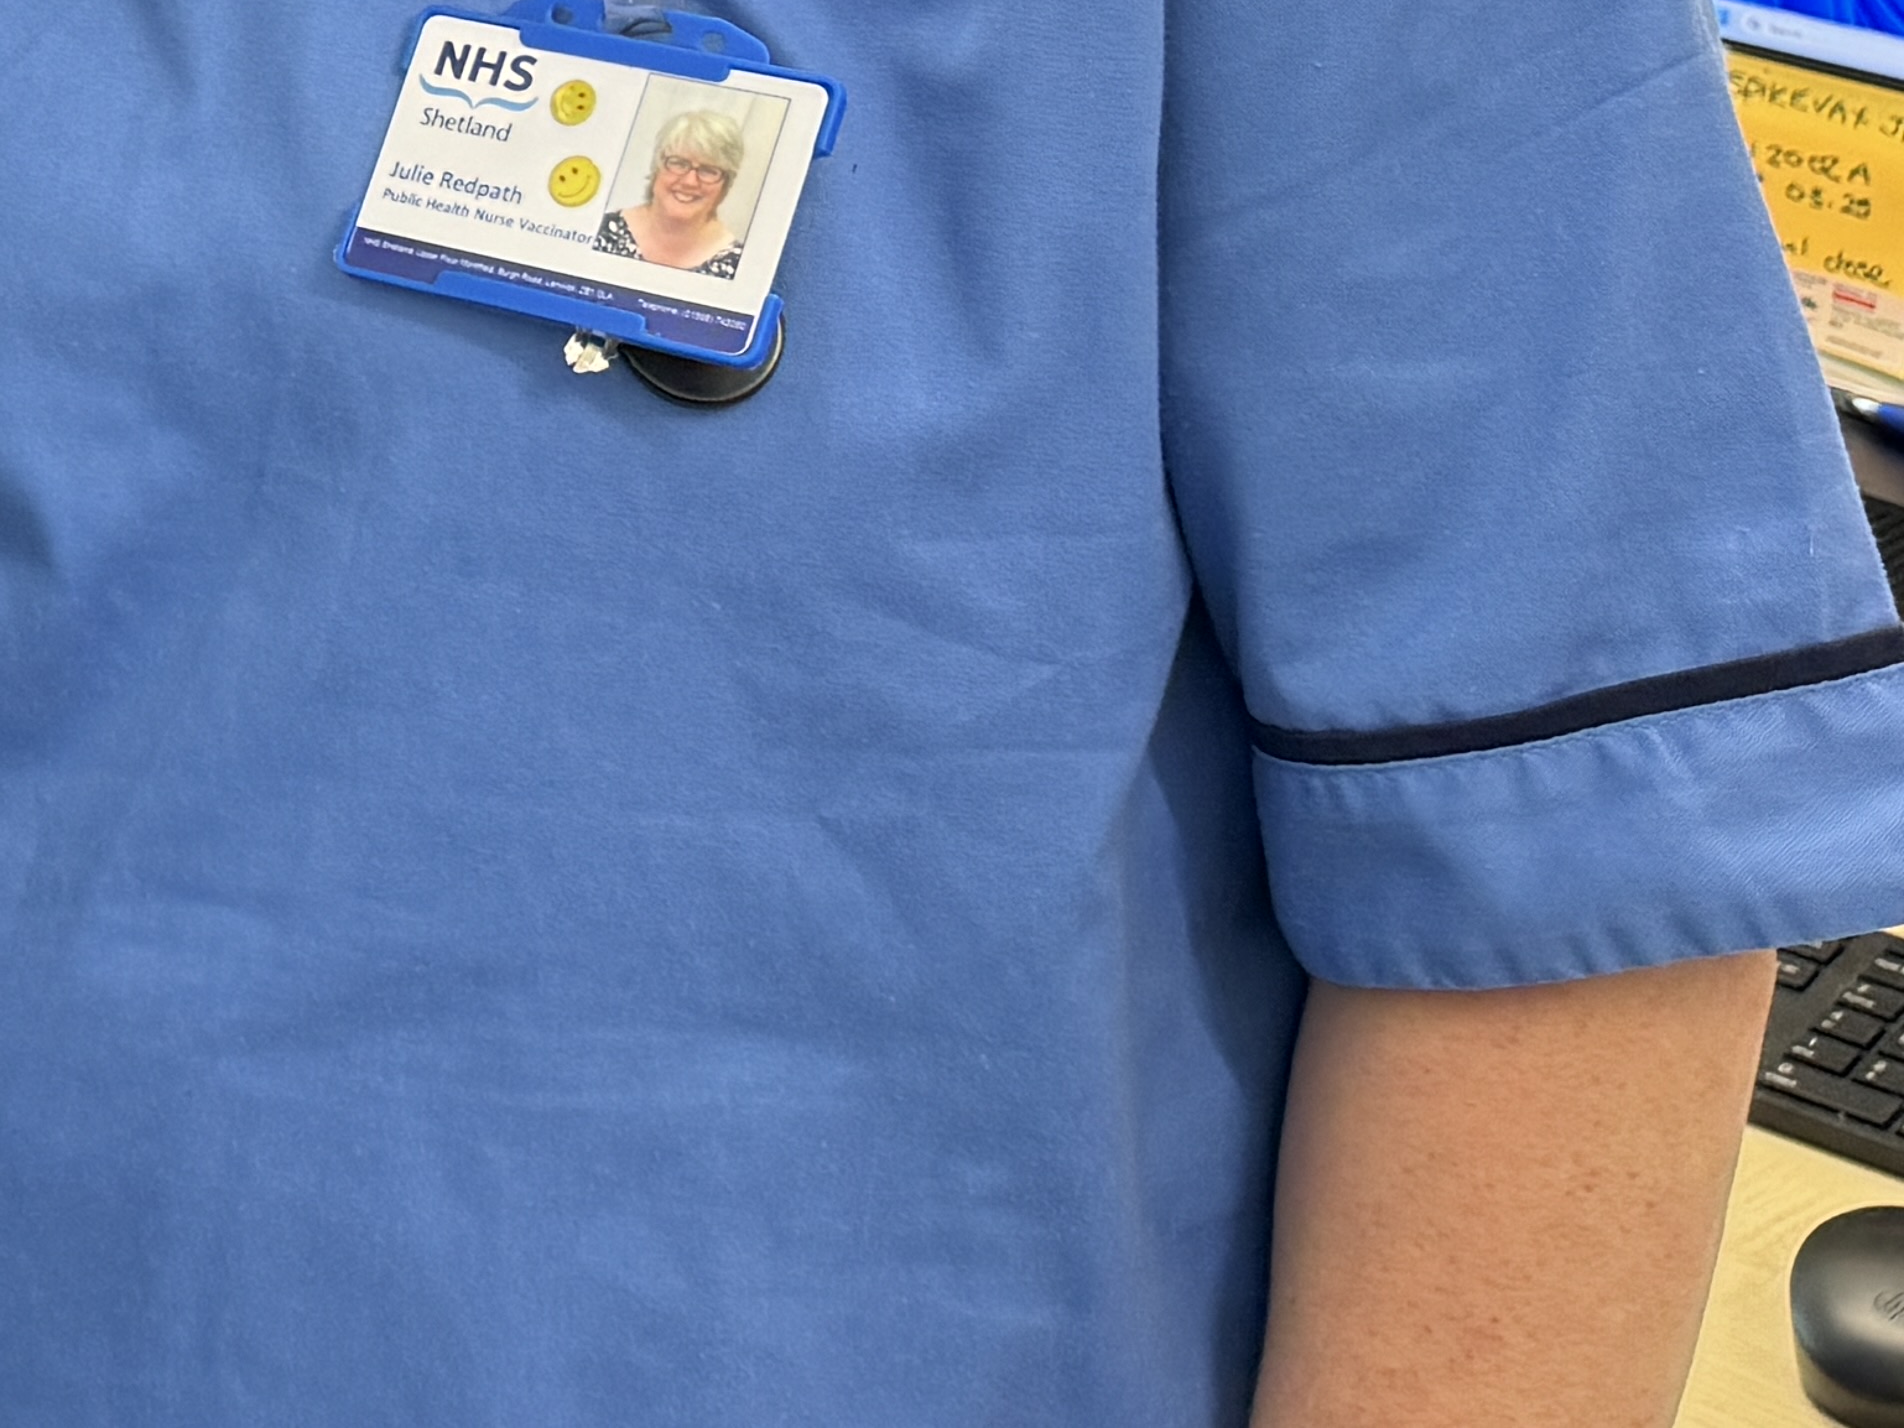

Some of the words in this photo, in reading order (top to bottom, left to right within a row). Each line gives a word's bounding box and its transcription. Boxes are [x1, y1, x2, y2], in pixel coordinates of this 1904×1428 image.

[433, 40, 538, 93] NHS
[419, 106, 512, 143] Shetland
[389, 160, 434, 186] Julie
[439, 170, 523, 205] Redpath
[382, 187, 423, 208] Public
[426, 198, 470, 218] Health
[474, 208, 515, 228] Nurse
[519, 217, 594, 245] Vaccinator
